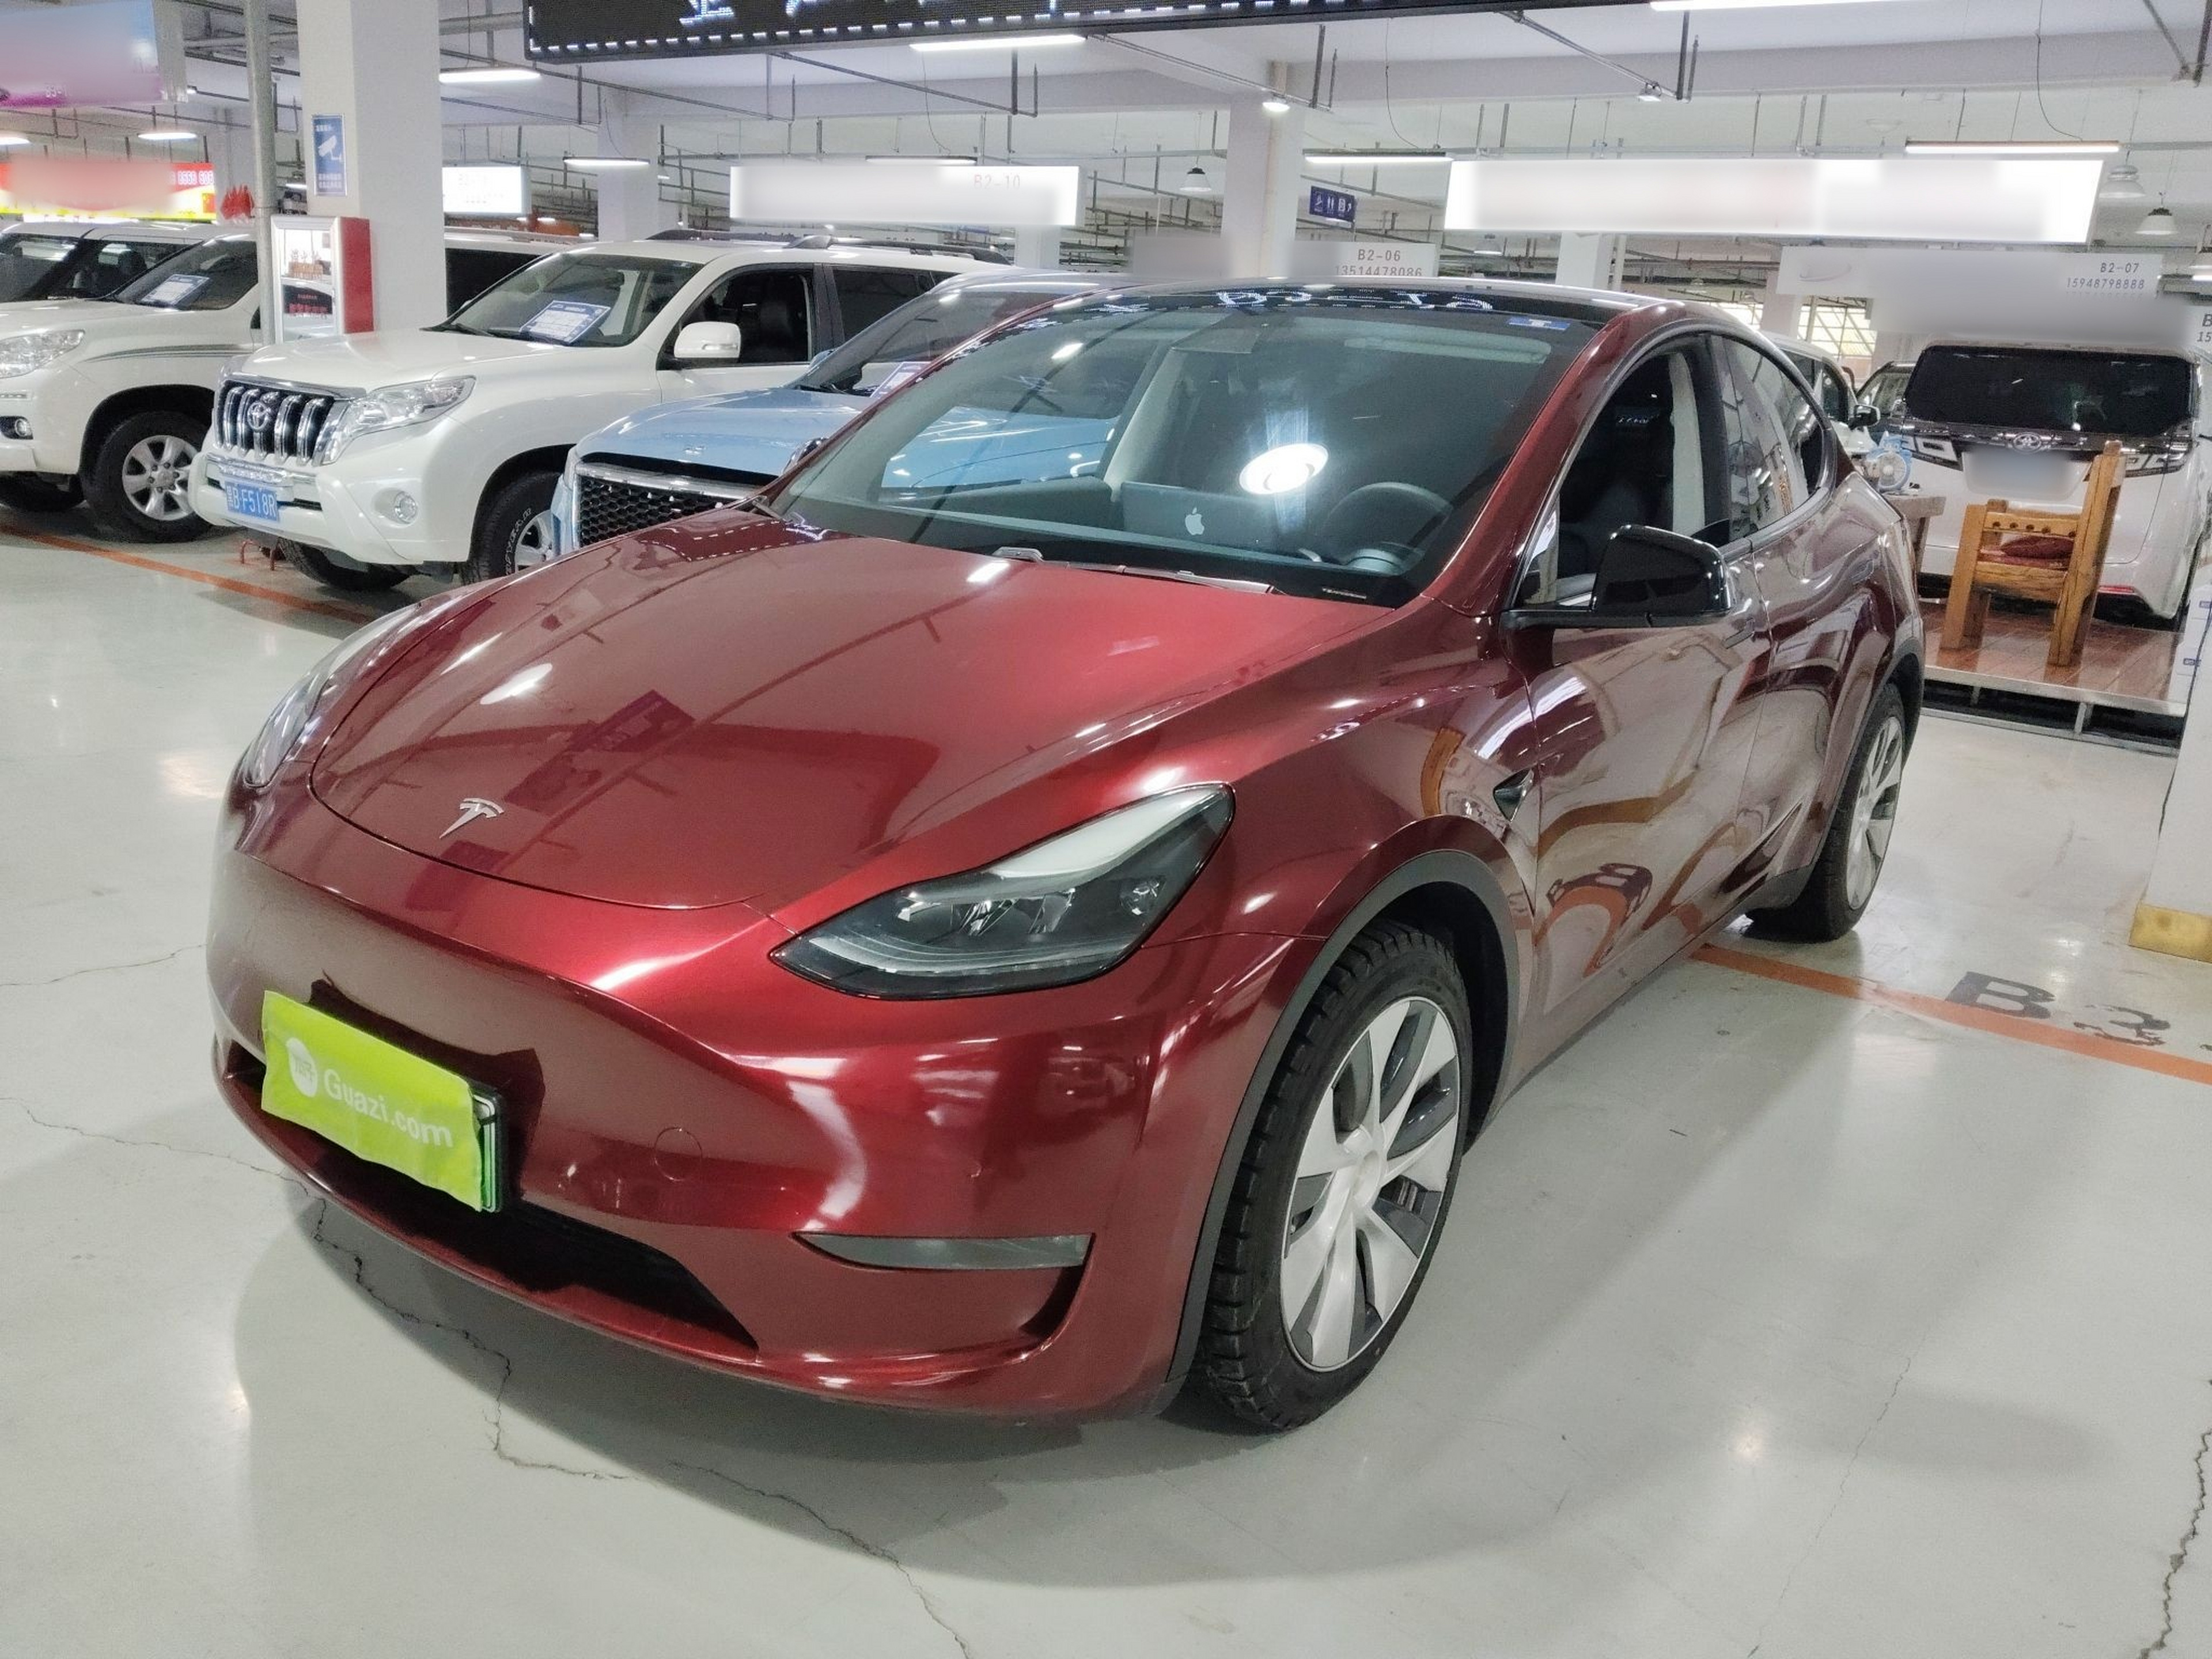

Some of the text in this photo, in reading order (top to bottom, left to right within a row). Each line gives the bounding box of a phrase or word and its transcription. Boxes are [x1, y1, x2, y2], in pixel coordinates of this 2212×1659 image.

[974, 174, 1020, 190] B2-10
[1358, 249, 1401, 261] B2-06
[2100, 263, 2139, 273] B2-07
[2066, 278, 2145, 289] 15948798888
[324, 1069, 454, 1147] Guazi.com
